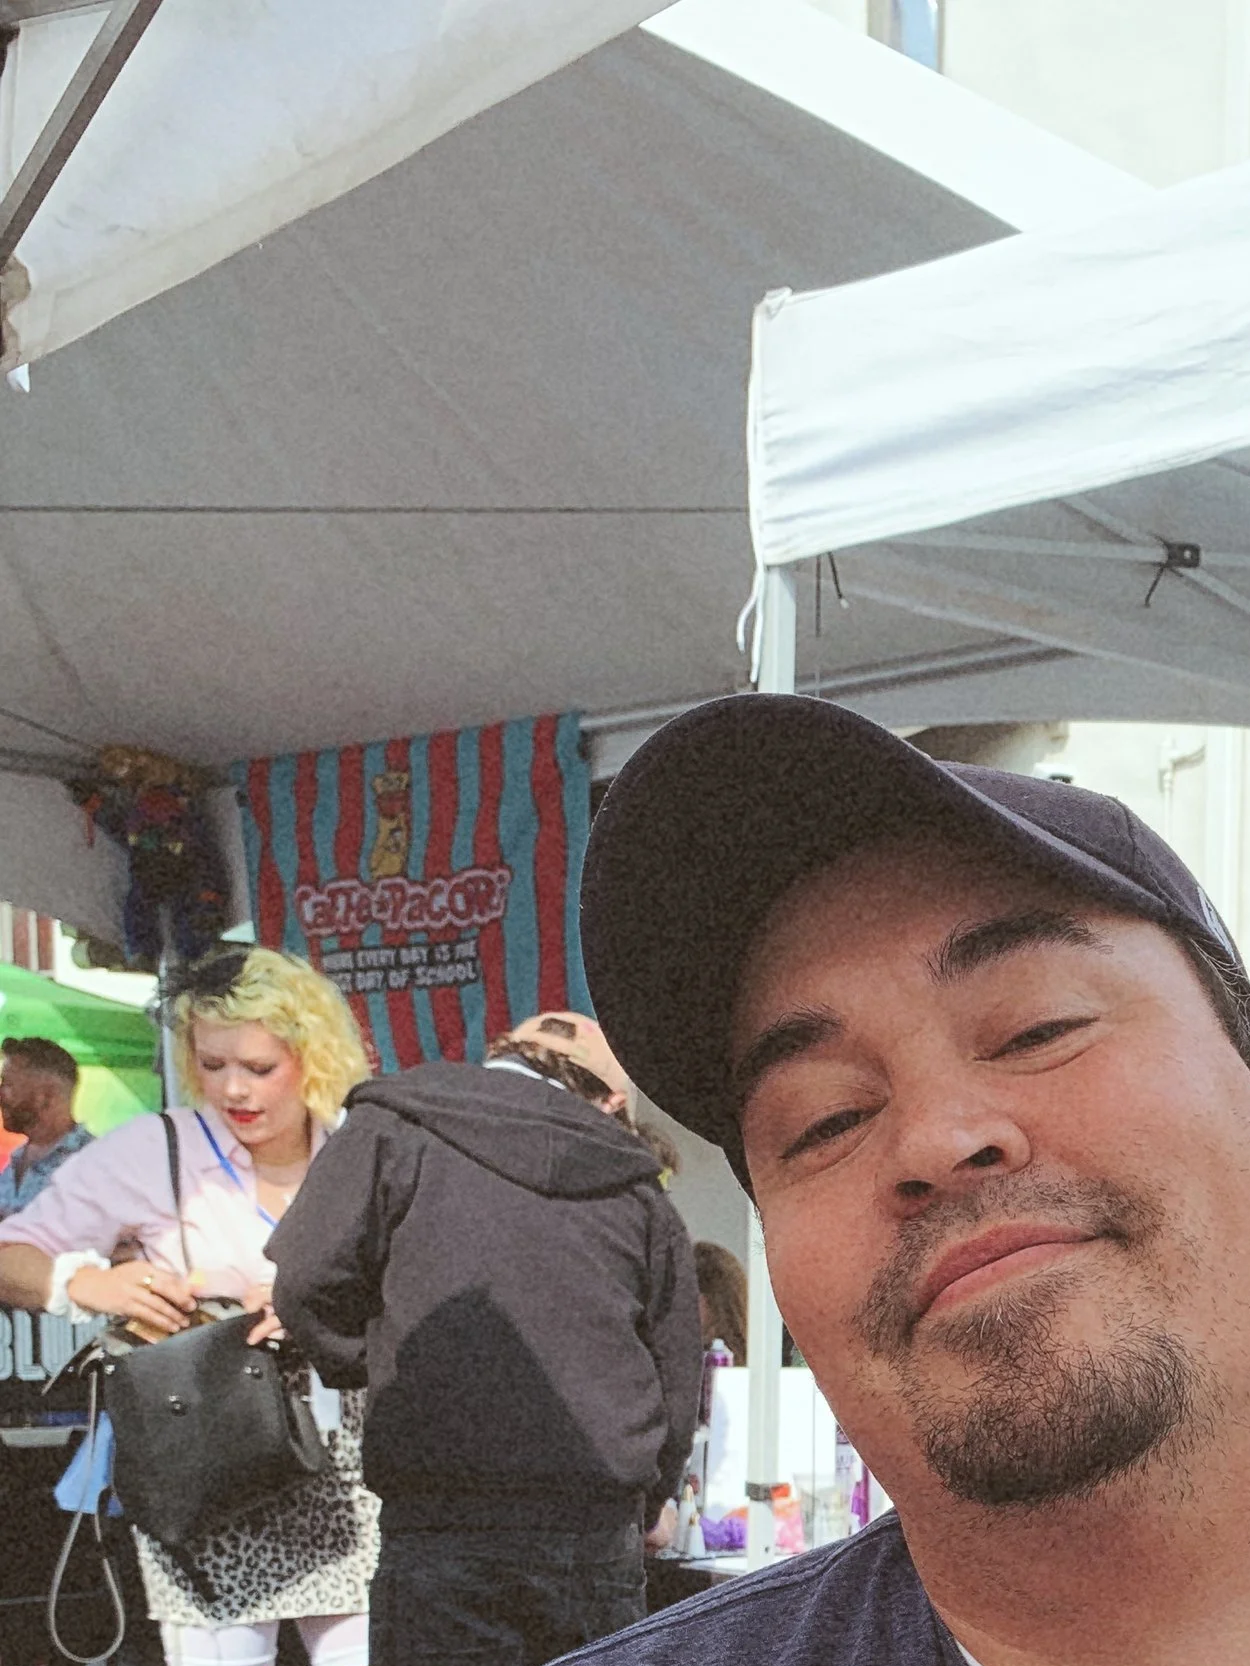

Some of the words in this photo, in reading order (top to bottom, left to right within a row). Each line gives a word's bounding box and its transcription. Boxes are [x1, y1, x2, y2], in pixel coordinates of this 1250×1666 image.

[356, 948, 395, 968] EVERY
[399, 946, 428, 965] DAY
[355, 970, 384, 991] DAY
[388, 969, 411, 989] OF
[414, 961, 477, 986] SCHOOL
